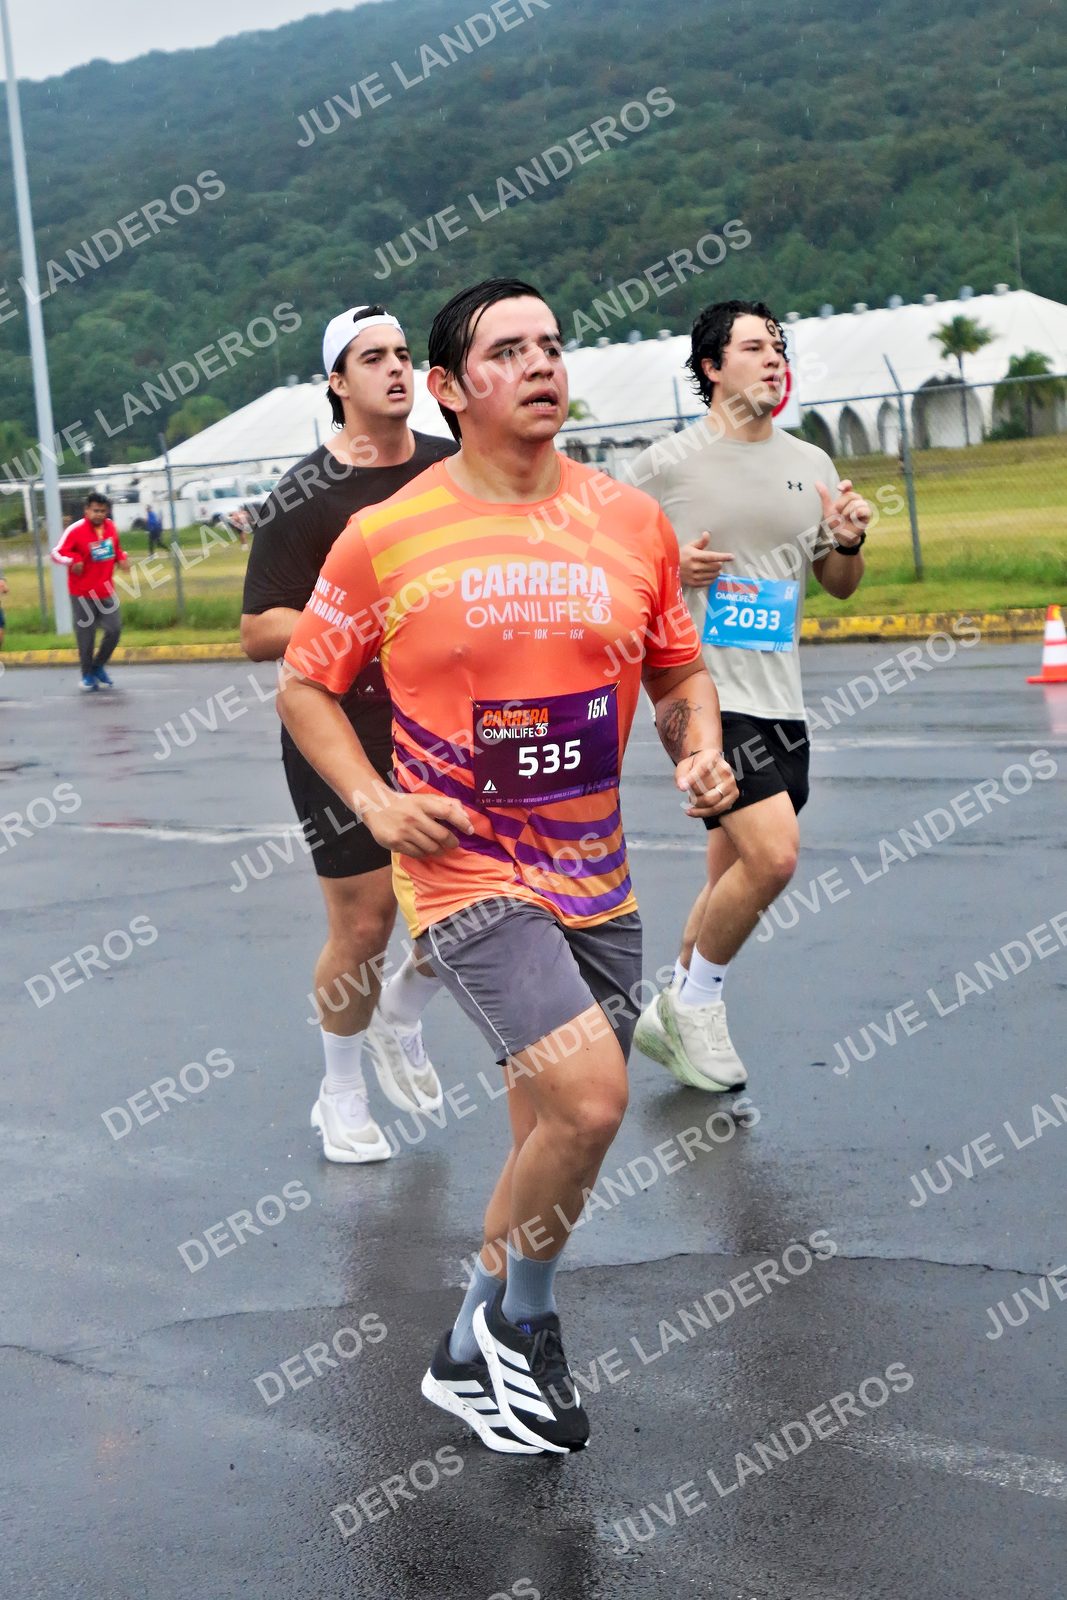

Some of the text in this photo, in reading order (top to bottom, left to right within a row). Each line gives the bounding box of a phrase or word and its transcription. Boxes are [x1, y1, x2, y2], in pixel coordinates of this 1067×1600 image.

[461, 561, 610, 602] CARRERA
[331, 586, 347, 605] TE
[723, 605, 781, 631] 2033
[534, 629, 548, 640] 10K
[482, 707, 549, 727] CARRERA
[587, 695, 609, 720] 15K
[518, 739, 581, 776] 535
